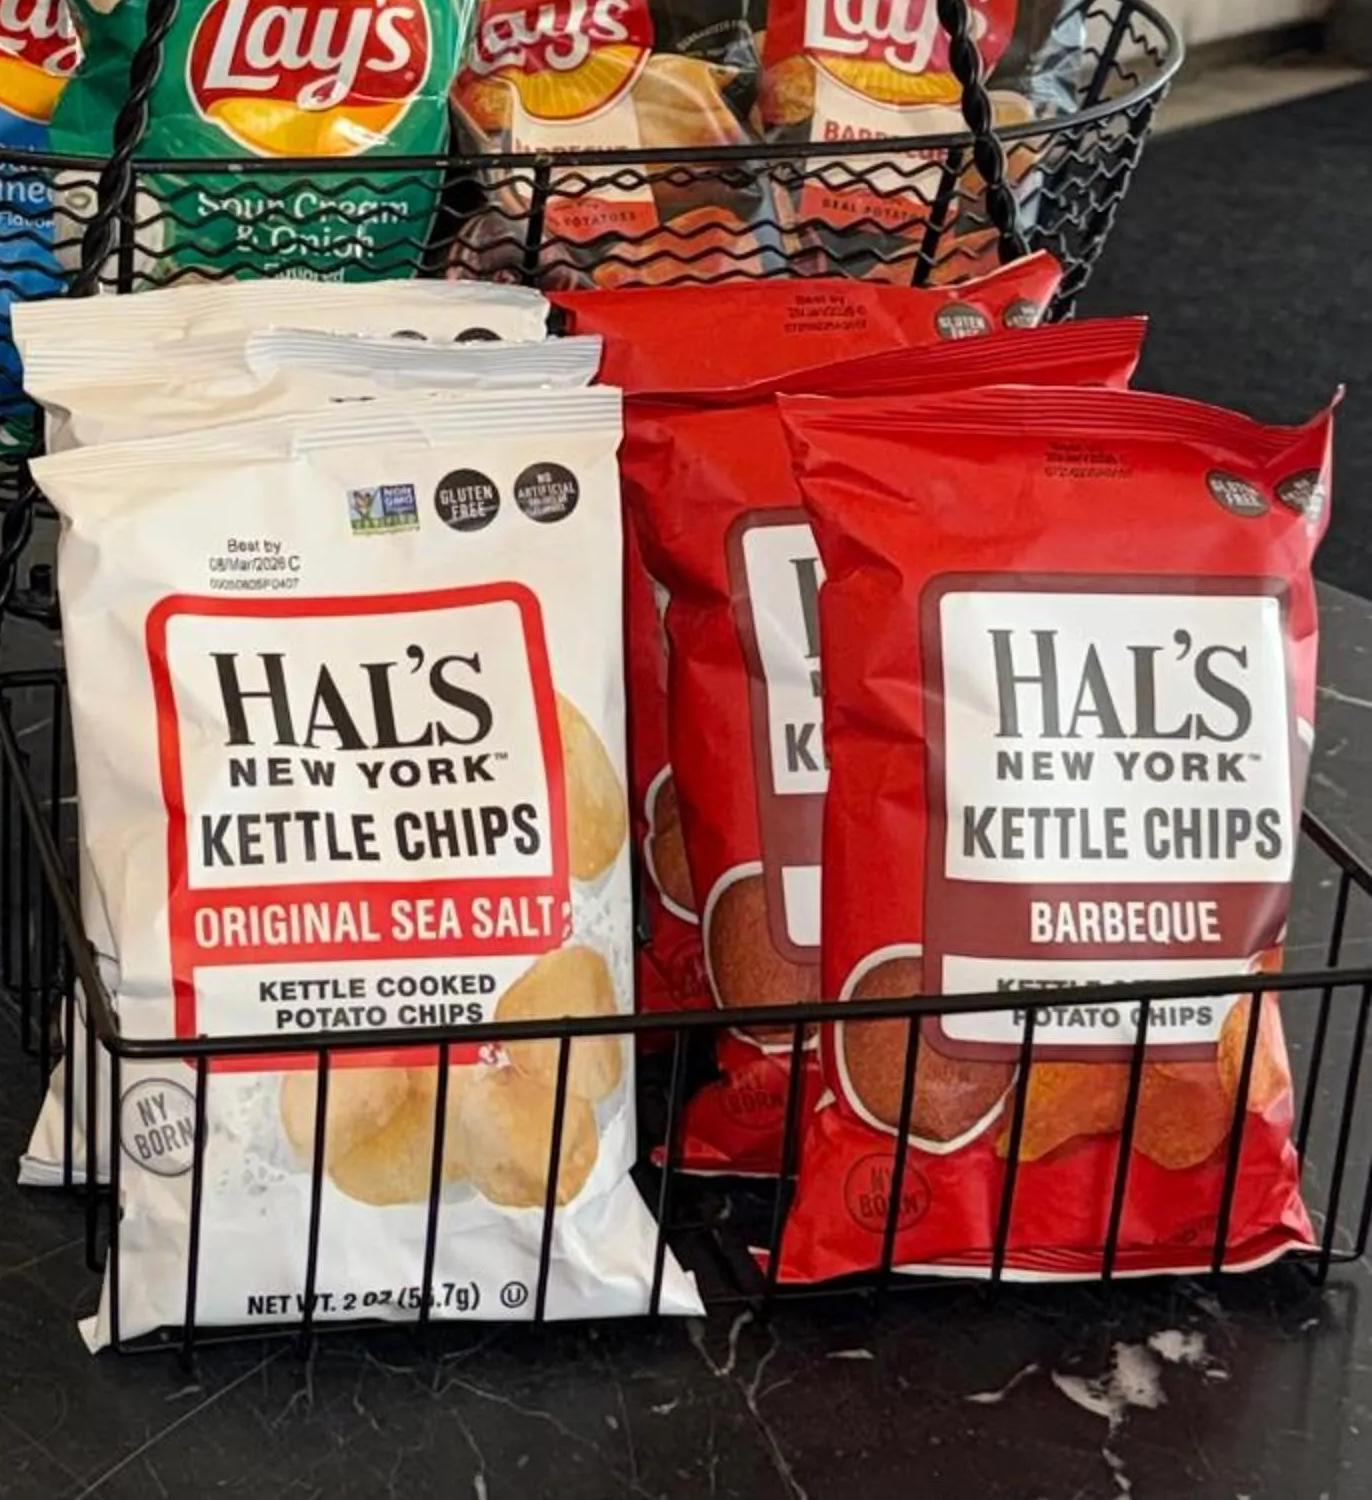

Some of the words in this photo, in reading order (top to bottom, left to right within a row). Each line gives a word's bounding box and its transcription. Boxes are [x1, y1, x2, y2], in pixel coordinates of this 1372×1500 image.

[198, 190, 284, 221] Sour
[293, 190, 410, 223] Cream
[235, 223, 257, 251] &
[271, 224, 375, 259] Onion
[938, 315, 985, 330] GLUTEN
[439, 485, 494, 505] GLUTEN
[517, 481, 576, 499] ARTIFICIAL
[1209, 476, 1260, 496] GLUTEN
[1227, 490, 1264, 508] FREE
[451, 501, 487, 518] FREE
[227, 538, 260, 553] Best
[263, 539, 283, 555] by
[288, 555, 301, 572] C
[209, 644, 494, 752] HAL'S
[988, 628, 1253, 742] HAL'S
[230, 757, 336, 788] NEW
[996, 750, 1093, 782] NEW
[201, 811, 380, 869] KETTLE
[395, 802, 541, 862] CHIPS
[962, 805, 1126, 861] KETTLE
[1144, 805, 1283, 861] CHIPS
[194, 901, 381, 949] ORIGINAL
[391, 899, 463, 941] SEA
[471, 895, 555, 937] SALT
[1030, 899, 1222, 946] BARBEQUE
[259, 978, 368, 1003] KETTLE
[375, 974, 497, 999] COOKED
[276, 1004, 387, 1030] POTATO
[396, 1002, 485, 1027] CHIPS
[138, 1092, 171, 1124] NY
[135, 1114, 194, 1162] BORN
[247, 1294, 292, 1315] NET
[343, 1292, 357, 1311] 2
[398, 1281, 481, 1313] (5.7g)
